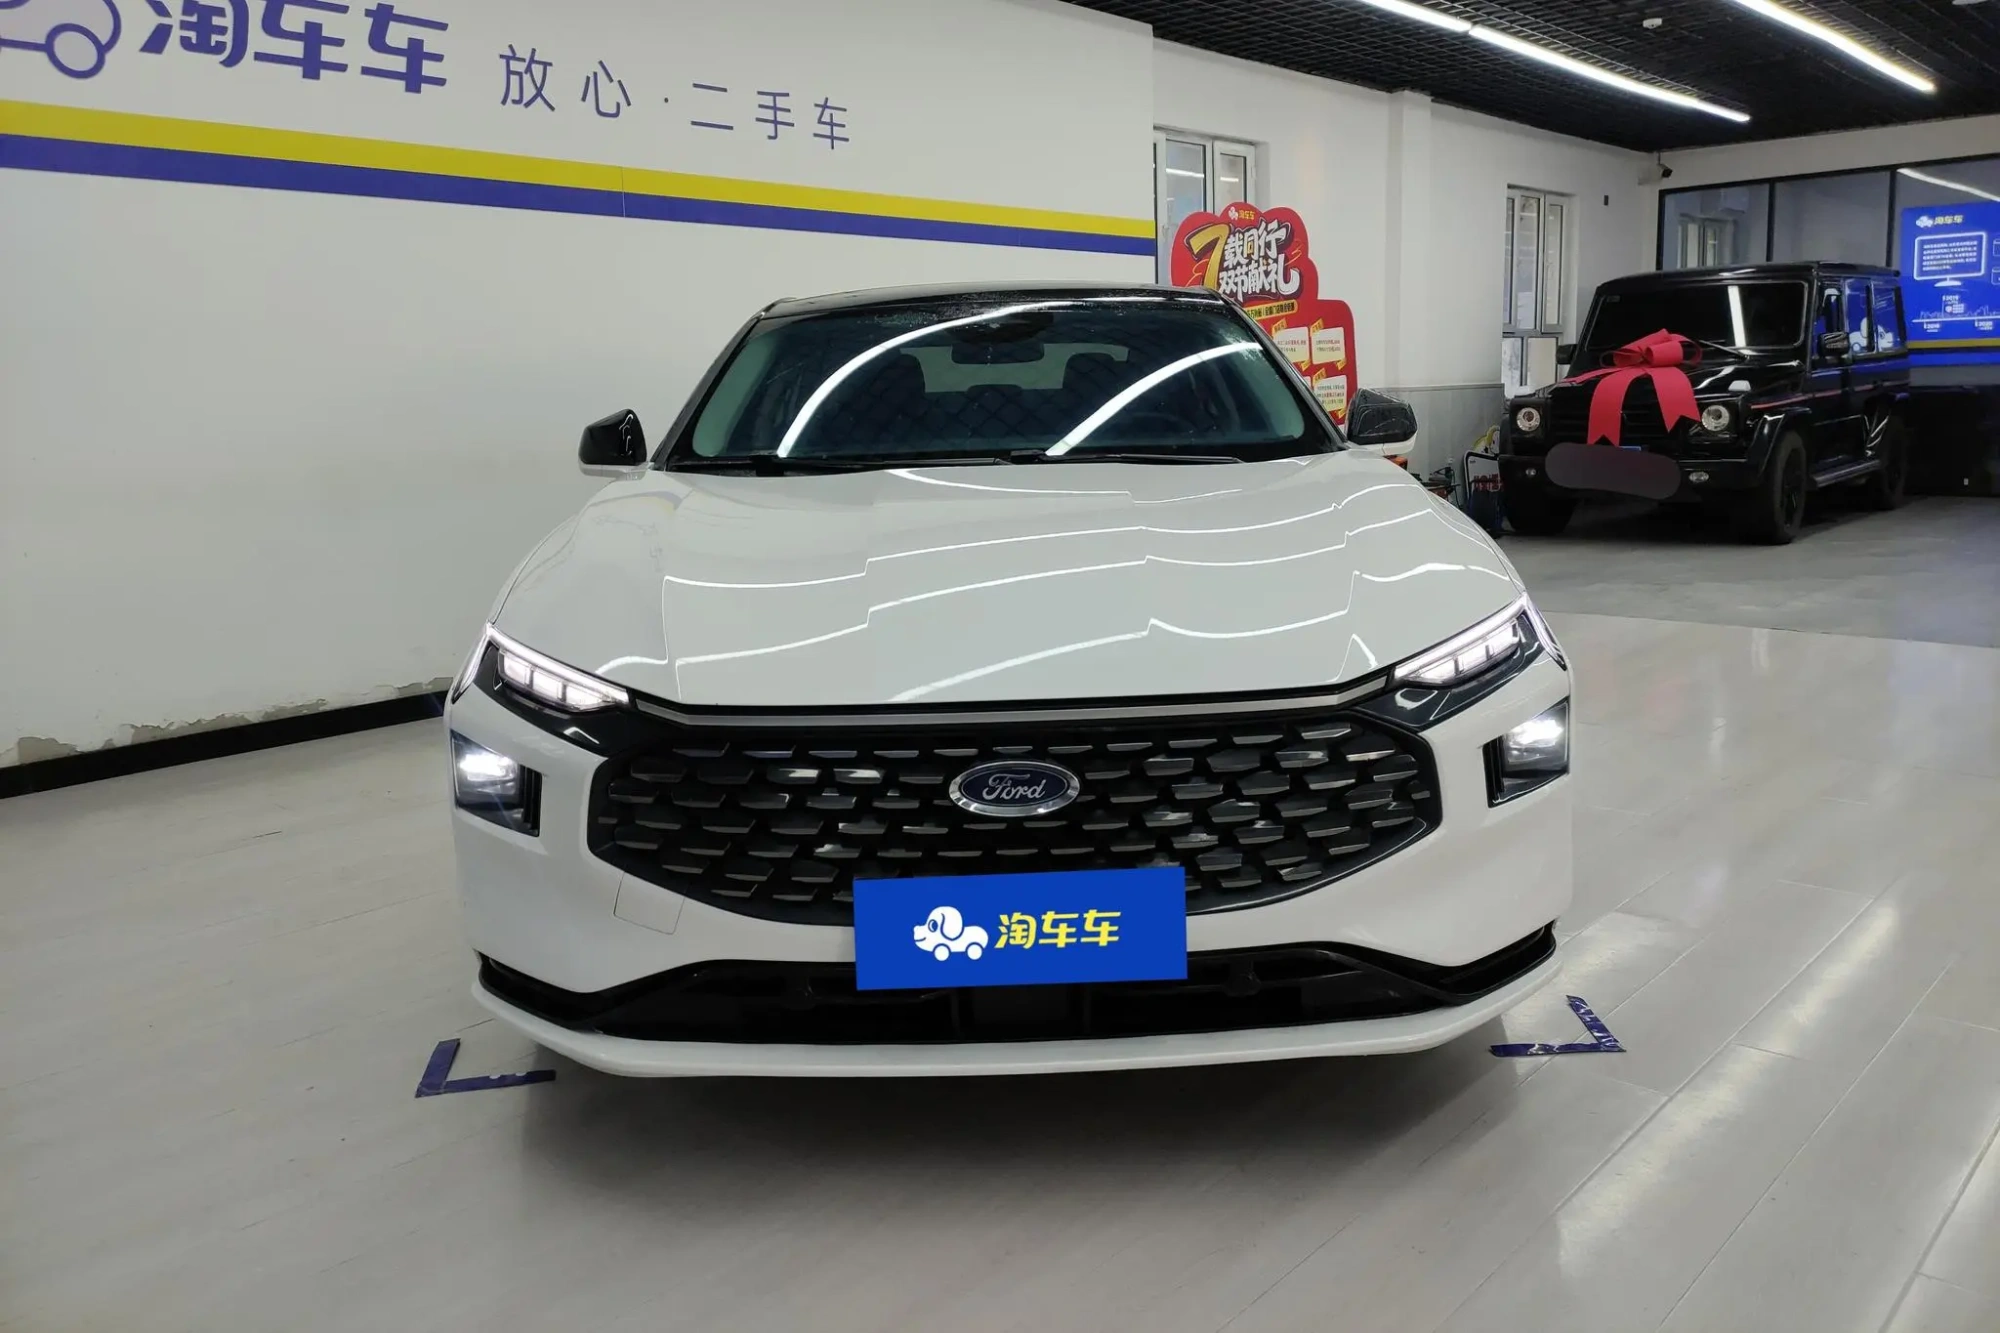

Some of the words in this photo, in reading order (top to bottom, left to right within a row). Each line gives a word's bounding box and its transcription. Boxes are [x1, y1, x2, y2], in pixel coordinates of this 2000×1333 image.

[1218, 253, 1300, 303] 双节献礼
[982, 774, 1047, 800] Ford
